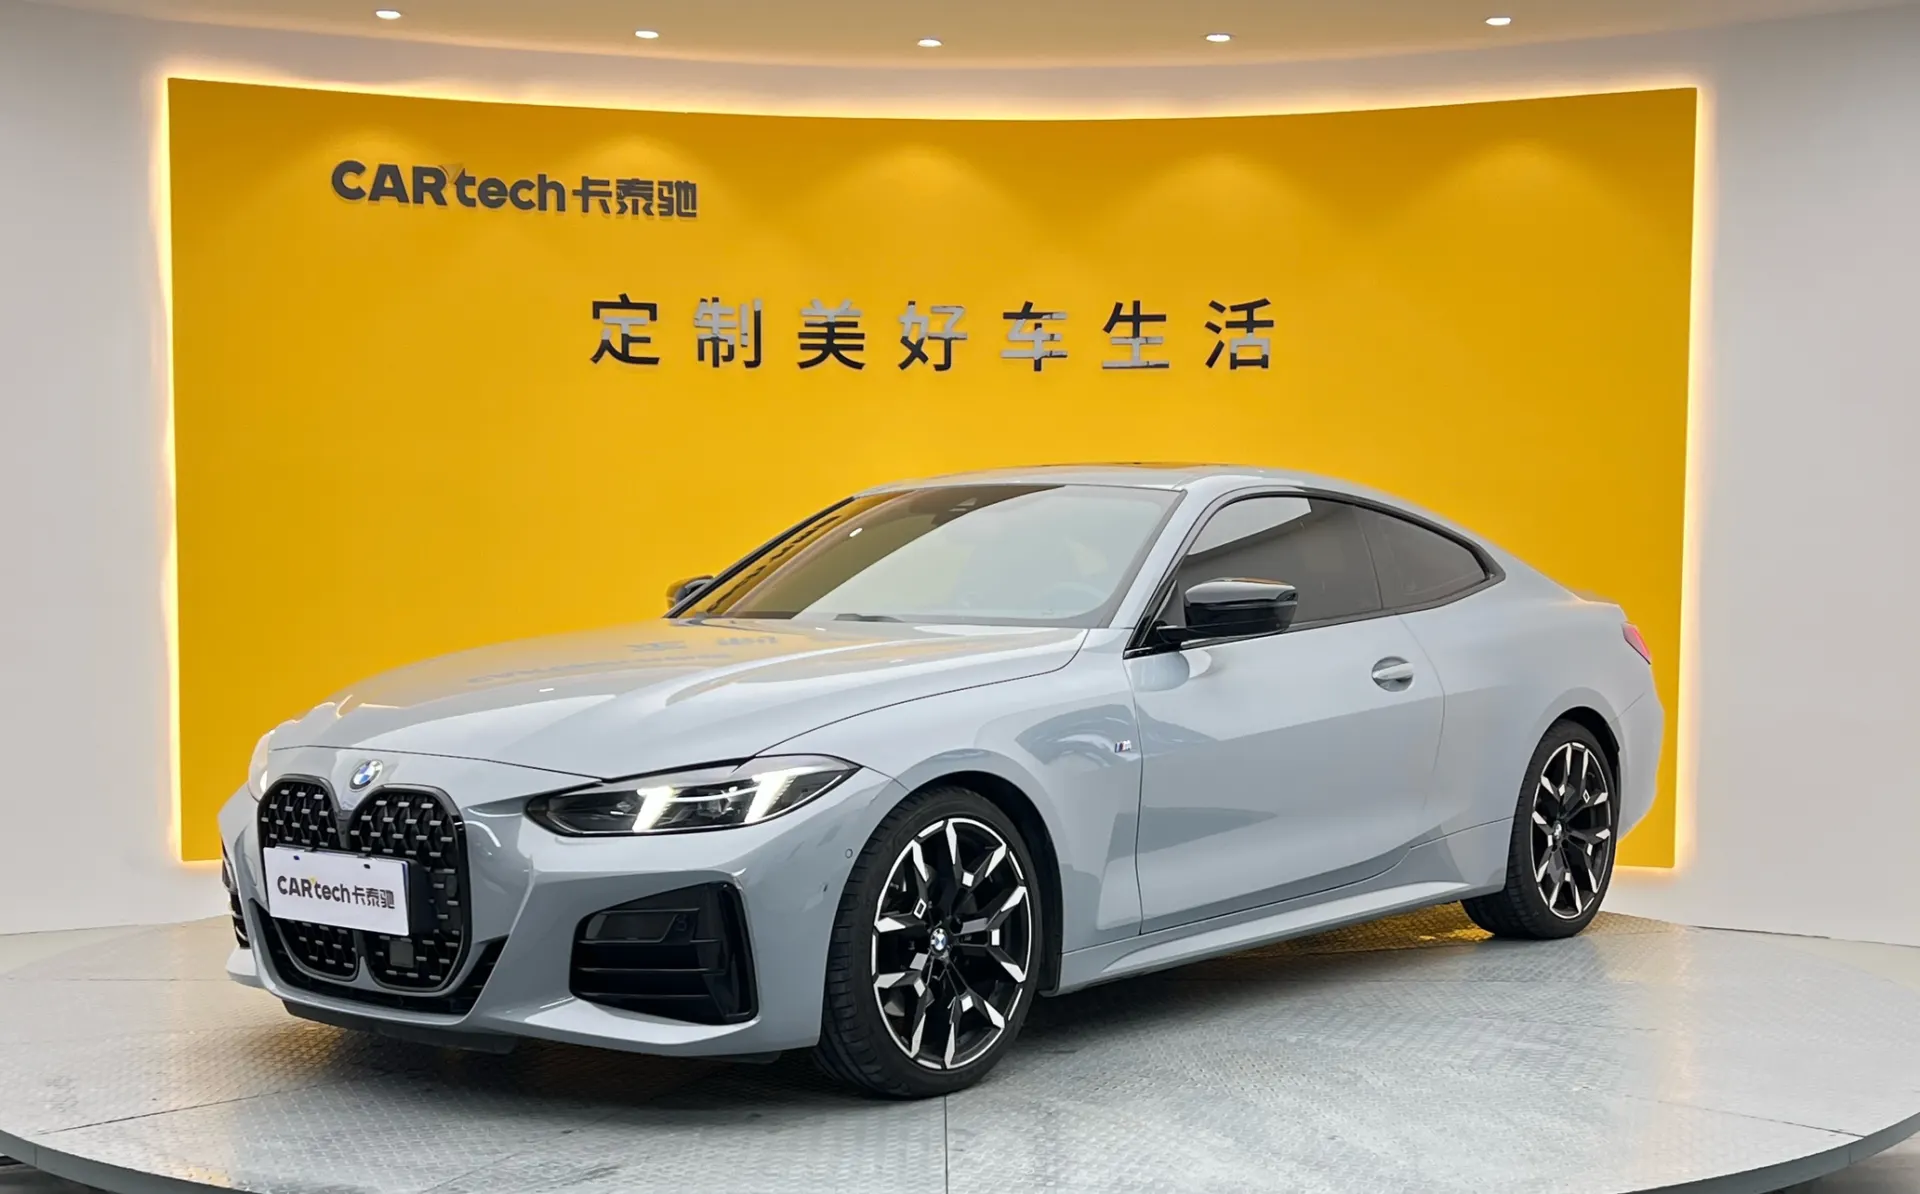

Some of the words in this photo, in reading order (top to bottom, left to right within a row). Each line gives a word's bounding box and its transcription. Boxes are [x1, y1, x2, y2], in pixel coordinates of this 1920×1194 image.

[331, 160, 567, 212] CARtech
[572, 175, 698, 218] 卡泰驰
[590, 293, 1275, 372] 定制美好车生活
[277, 875, 351, 904] CARtech
[352, 885, 396, 910] 卡泰驰
